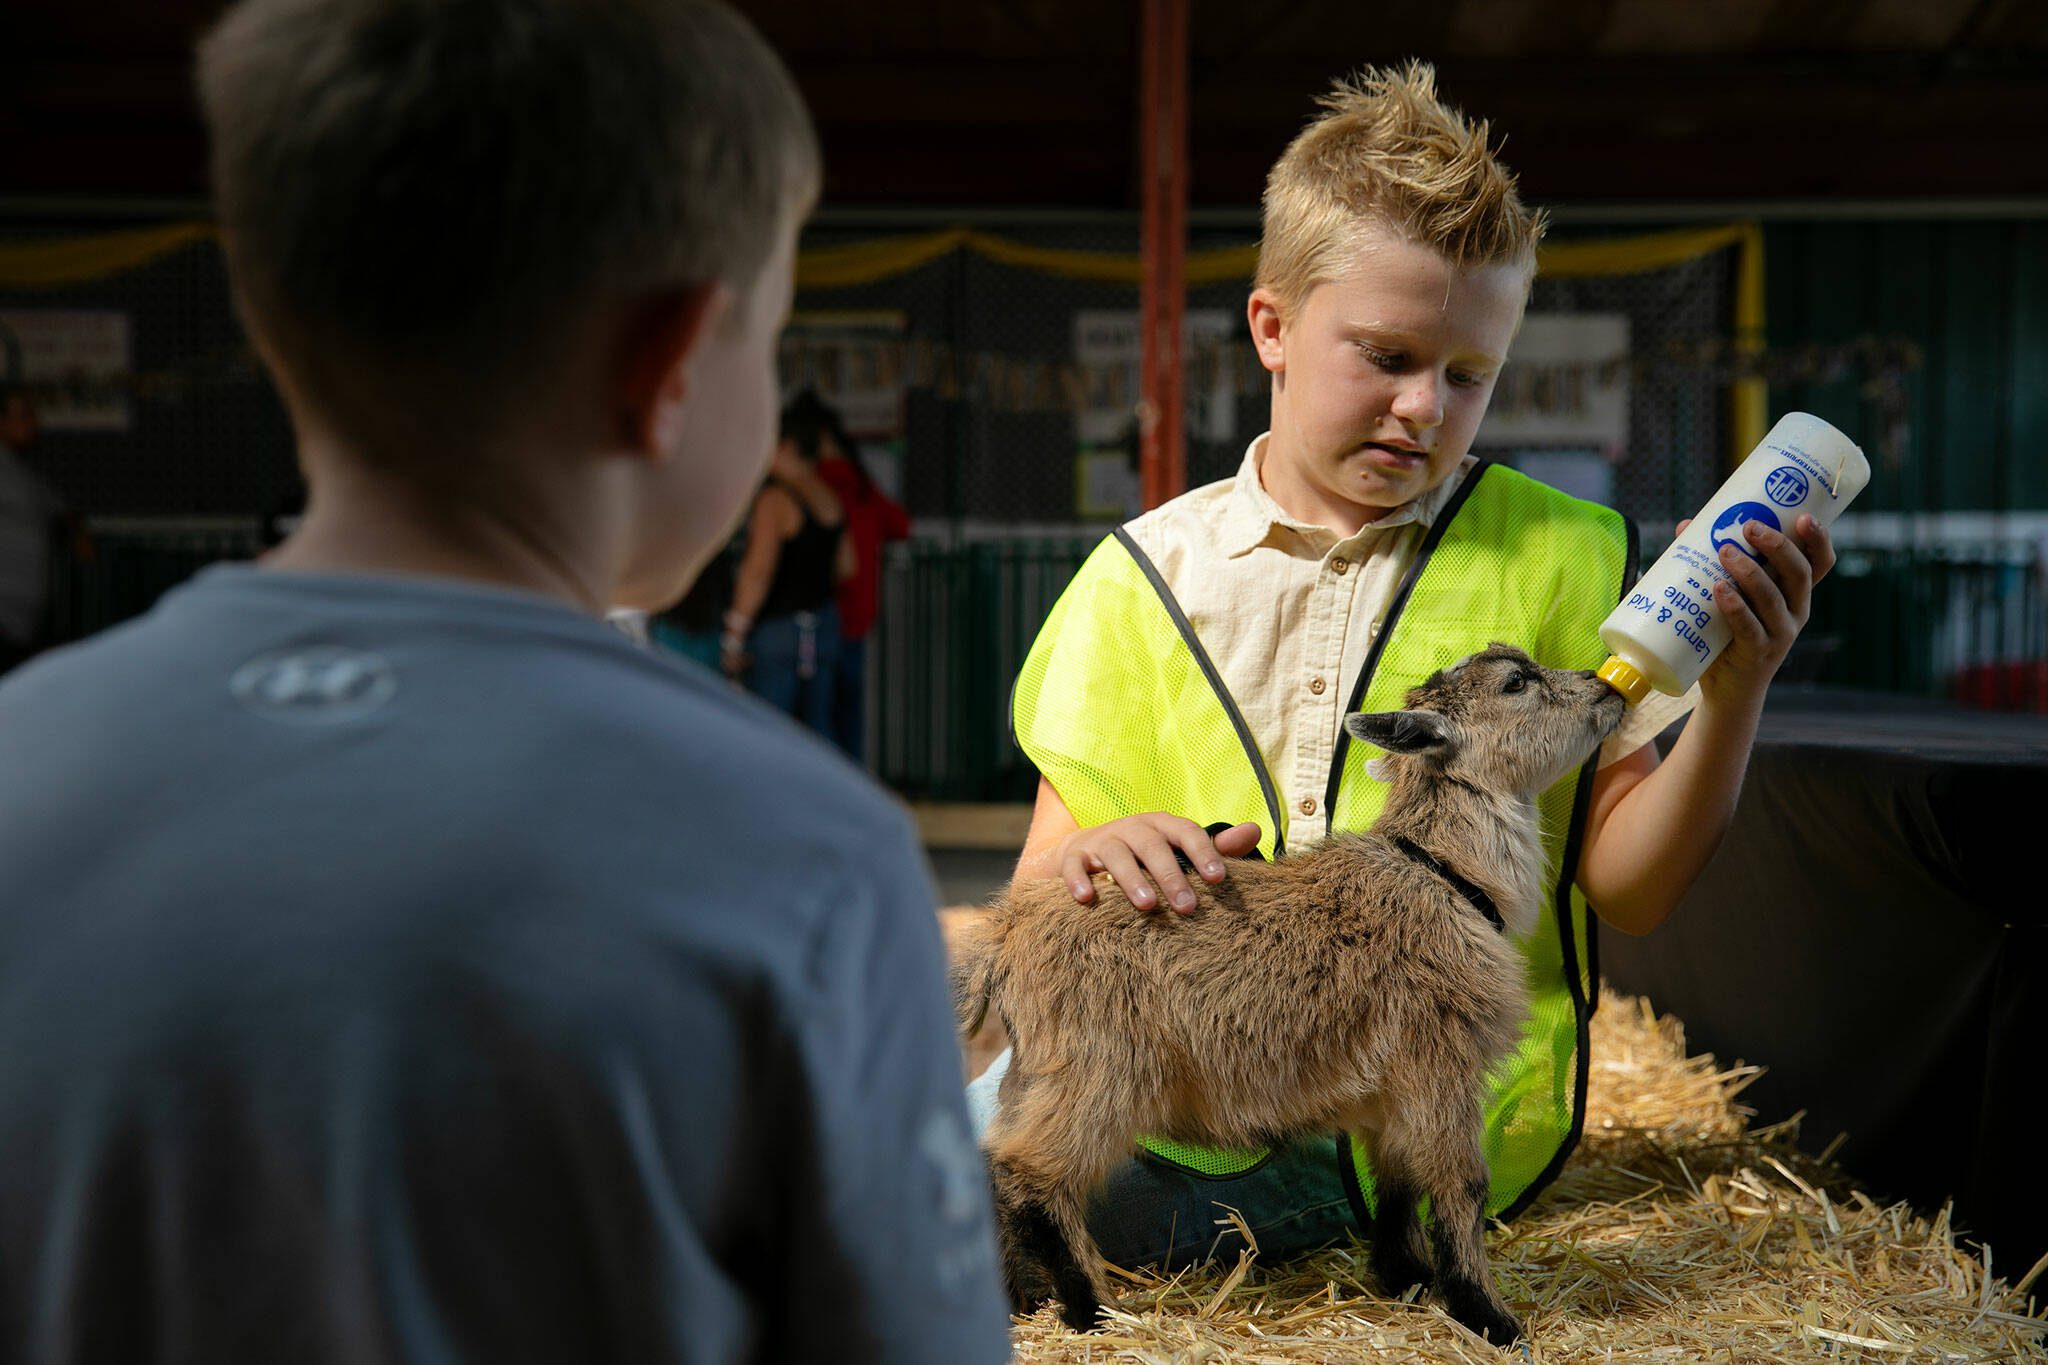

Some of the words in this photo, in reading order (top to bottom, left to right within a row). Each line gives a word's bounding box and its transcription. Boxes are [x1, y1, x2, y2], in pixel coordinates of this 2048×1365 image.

[1780, 449, 1818, 478] ENTERPRISES
[1766, 467, 1807, 505] APE
[1691, 549, 1710, 563] Valve
[1702, 567, 1714, 579] the
[1686, 577, 1700, 589] oz
[1627, 593, 1656, 614] Kid
[1700, 587, 1713, 602] 16
[1656, 606, 1673, 623] &
[1664, 585, 1711, 629] Bottle
[1674, 619, 1711, 664] Lamb
